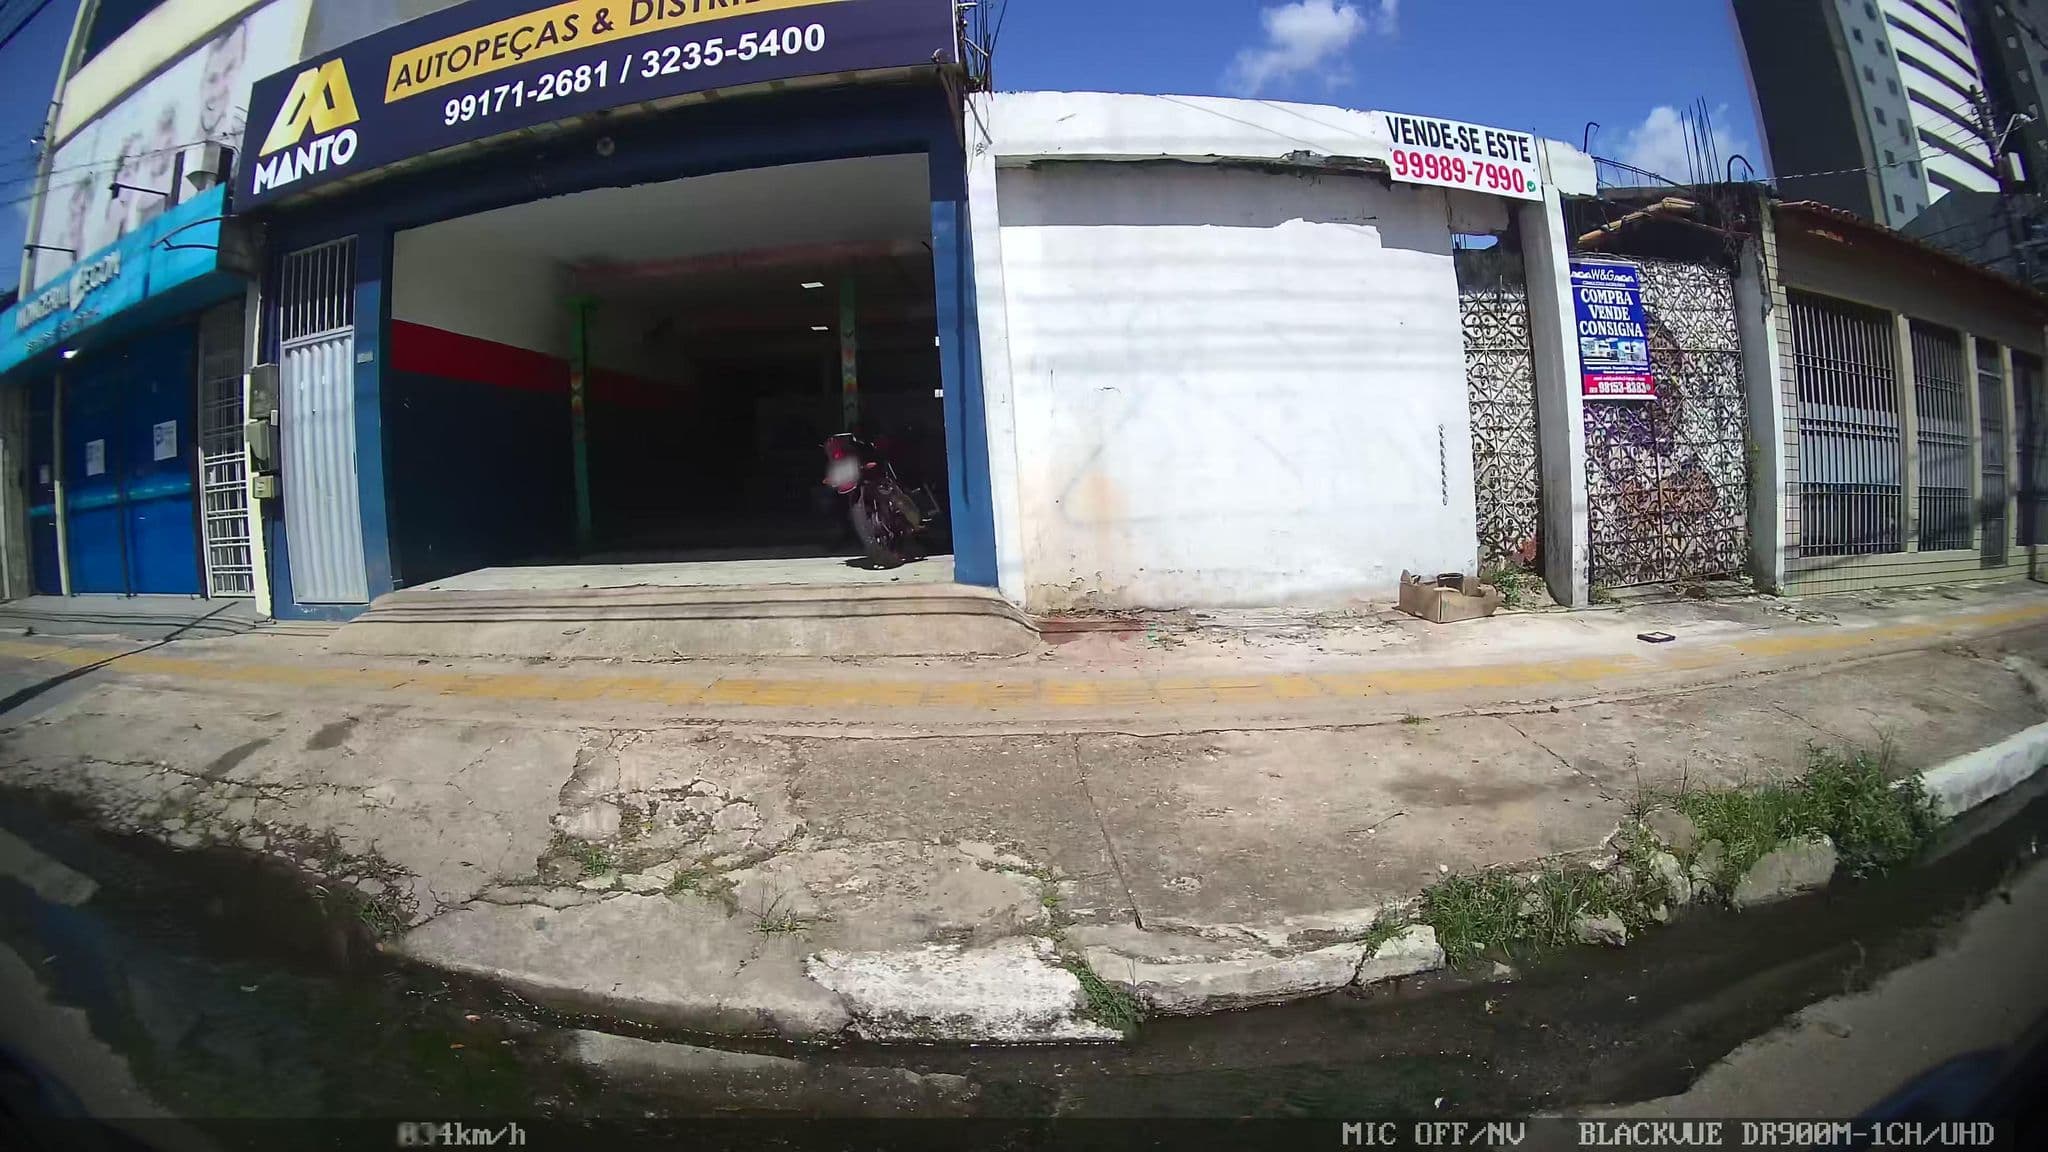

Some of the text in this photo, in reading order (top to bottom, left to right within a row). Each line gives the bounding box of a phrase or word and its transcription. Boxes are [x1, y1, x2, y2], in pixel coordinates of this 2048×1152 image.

[392, 0, 761, 91] AUTOPEÇAS & DIST
[445, 23, 825, 125] 99171-2681 / 3235-5400
[253, 129, 357, 194] MANTO
[1386, 115, 1531, 163] VENDE-SE ESTE
[1393, 150, 1525, 193] 99989-7990
[1581, 288, 1633, 305] COMPRA
[1588, 304, 1630, 320] VENDE
[1580, 320, 1644, 337] CONSIGNA
